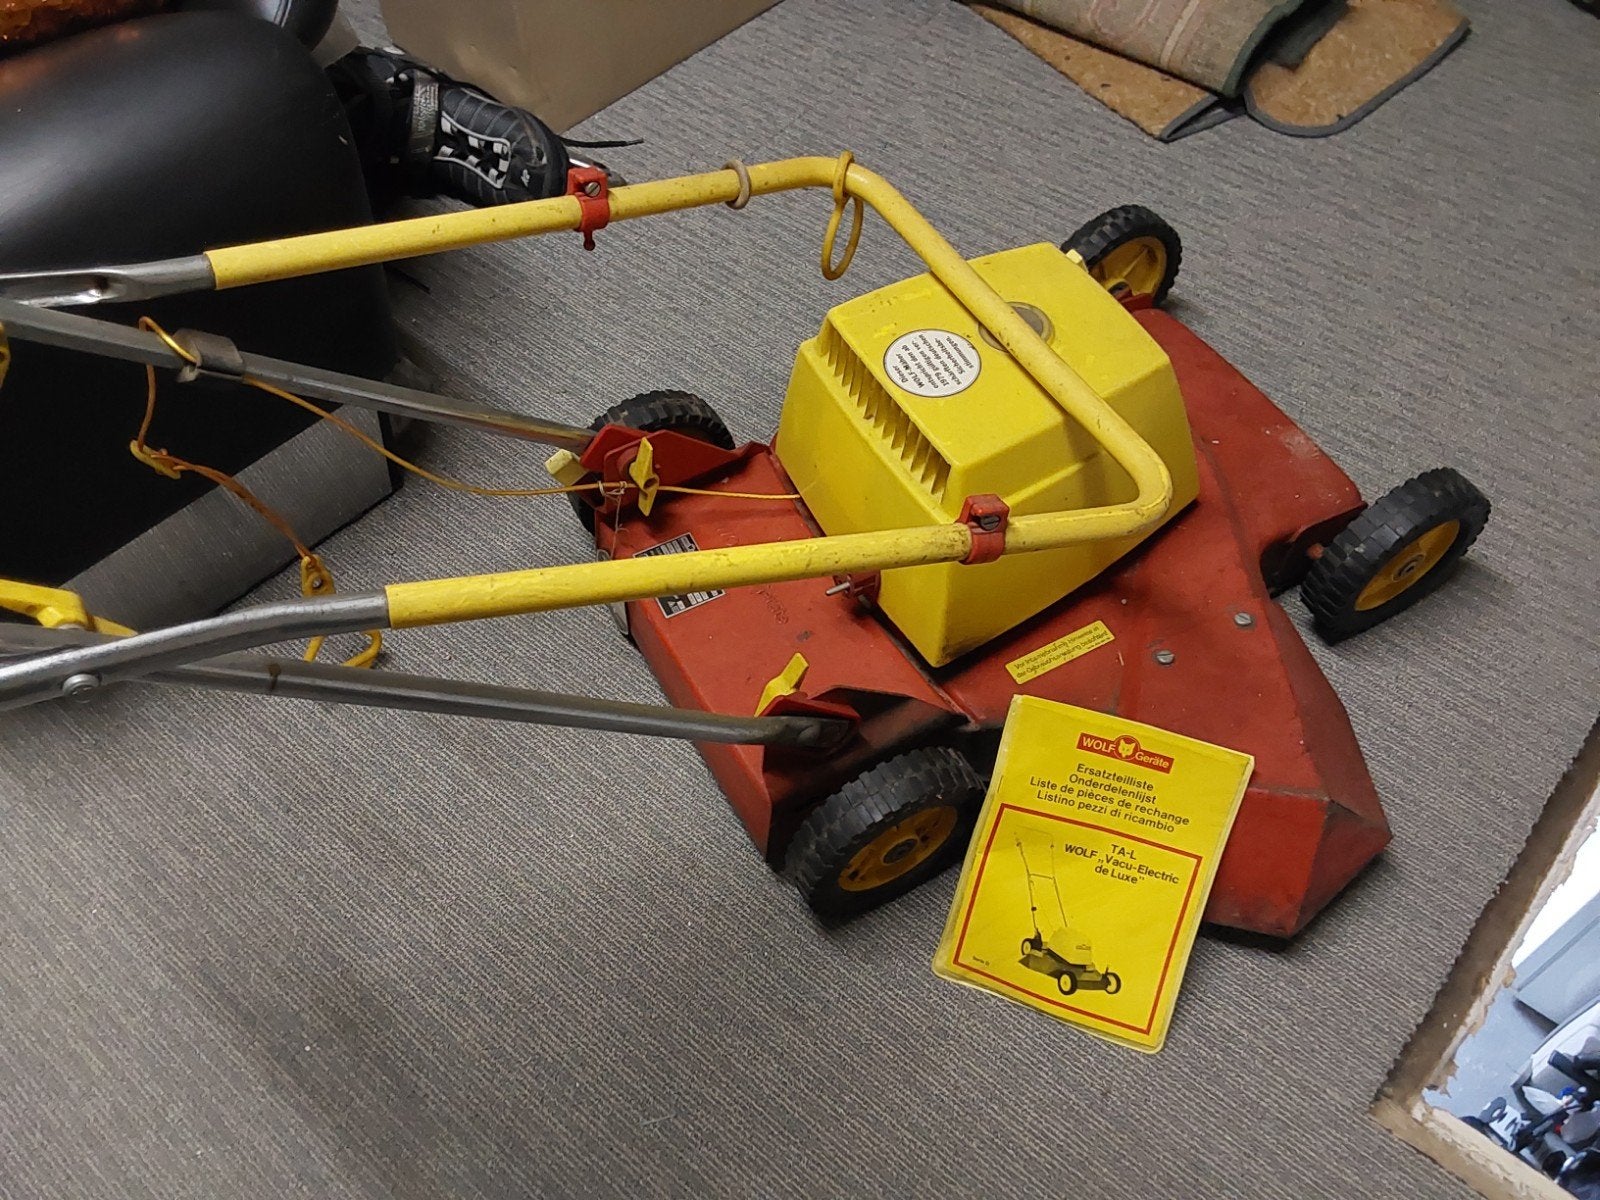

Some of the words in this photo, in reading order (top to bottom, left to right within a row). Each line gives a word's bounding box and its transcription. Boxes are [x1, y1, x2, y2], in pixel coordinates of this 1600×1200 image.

[901, 344, 910, 352] ab
[907, 352, 918, 363] den
[918, 334, 942, 360] deutschen
[892, 365, 908, 383] Dieser
[915, 361, 938, 388] entspricht
[934, 371, 949, 387] 1979
[1082, 736, 1116, 753] WOLF
[1135, 752, 1169, 768] Geräte
[1077, 764, 1154, 791] Ersatzteilliste
[1069, 775, 1156, 804] Onderdelenlijst
[1030, 776, 1056, 790] Liste
[1061, 783, 1074, 794] de
[1077, 788, 1114, 805] pièces
[1118, 798, 1132, 809] de
[1135, 802, 1190, 826] rechange
[1037, 792, 1076, 807] Listino
[1078, 801, 1107, 816] pezzi
[1111, 807, 1121, 818] di
[1124, 812, 1175, 833] ricambio
[1064, 843, 1097, 859] WOLF
[1111, 844, 1136, 860] TA-L
[1095, 865, 1109, 875] de
